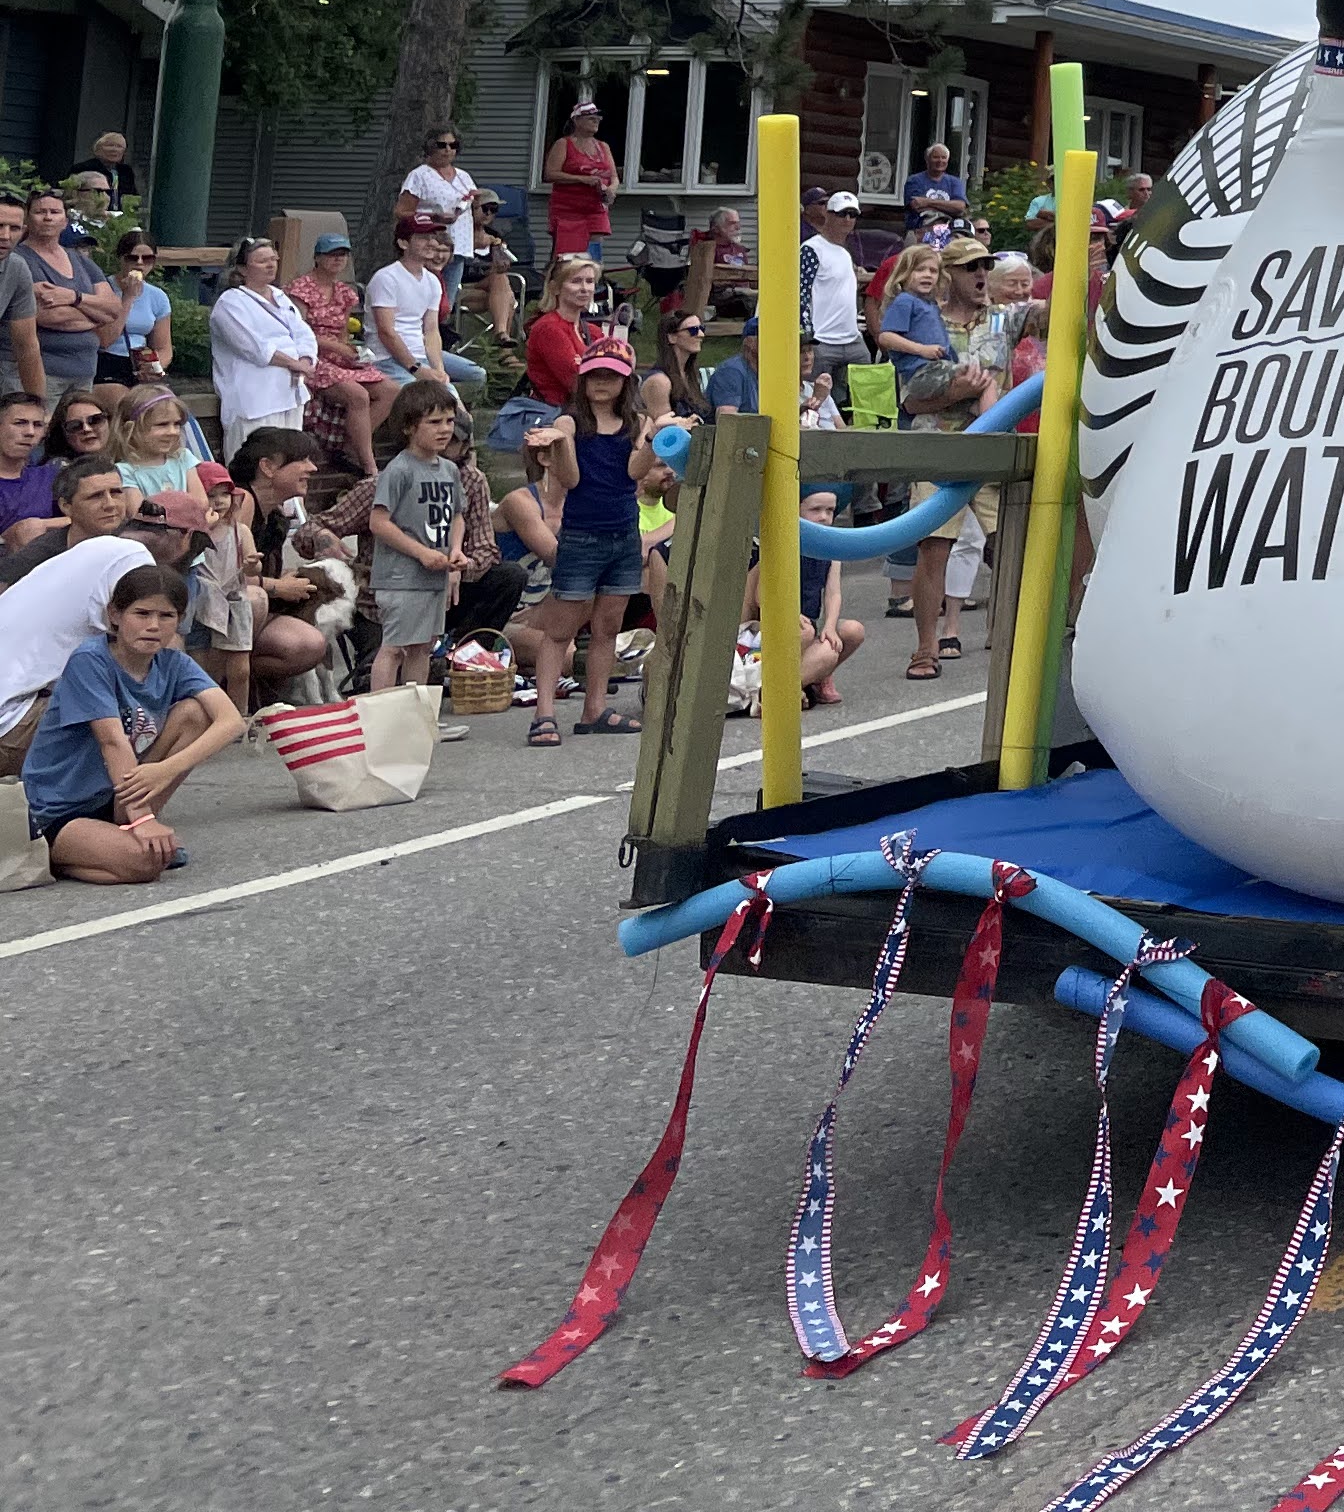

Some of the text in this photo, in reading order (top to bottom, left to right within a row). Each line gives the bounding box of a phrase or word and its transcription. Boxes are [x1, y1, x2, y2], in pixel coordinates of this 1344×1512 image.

[418, 481, 455, 504] JUST
[428, 503, 453, 526] DO
[435, 525, 451, 548] IT
